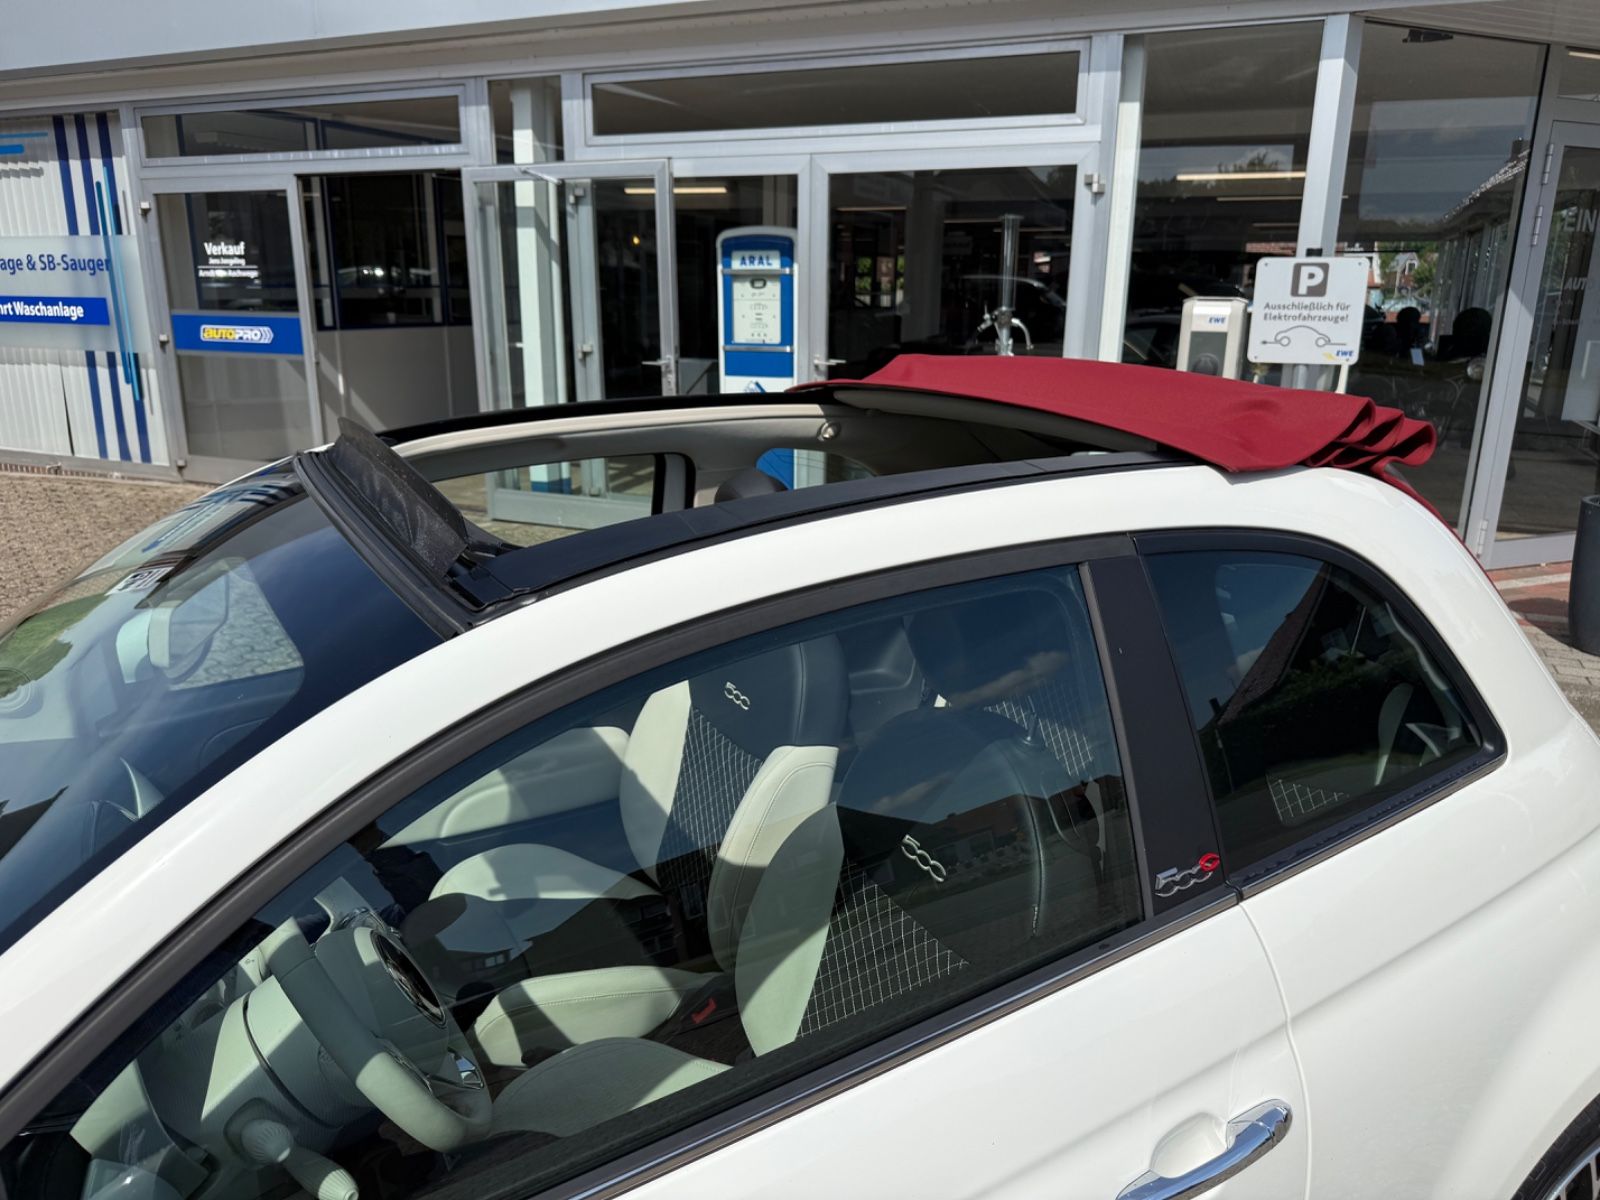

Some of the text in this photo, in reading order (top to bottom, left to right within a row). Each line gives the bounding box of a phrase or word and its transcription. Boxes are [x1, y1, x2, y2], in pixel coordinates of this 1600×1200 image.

[204, 241, 245, 255] Verkauf
[26, 253, 36, 271] &
[740, 256, 773, 266] ARAL
[1298, 265, 1324, 295] P
[13, 300, 84, 321] Waschanlage
[1264, 302, 1351, 312] Ausschließlich für
[1208, 316, 1226, 325] EWE
[1264, 313, 1349, 324] Elektrofahrzeuge!
[1336, 349, 1354, 358] EWE
[724, 681, 750, 710] 500
[901, 834, 947, 882] 500
